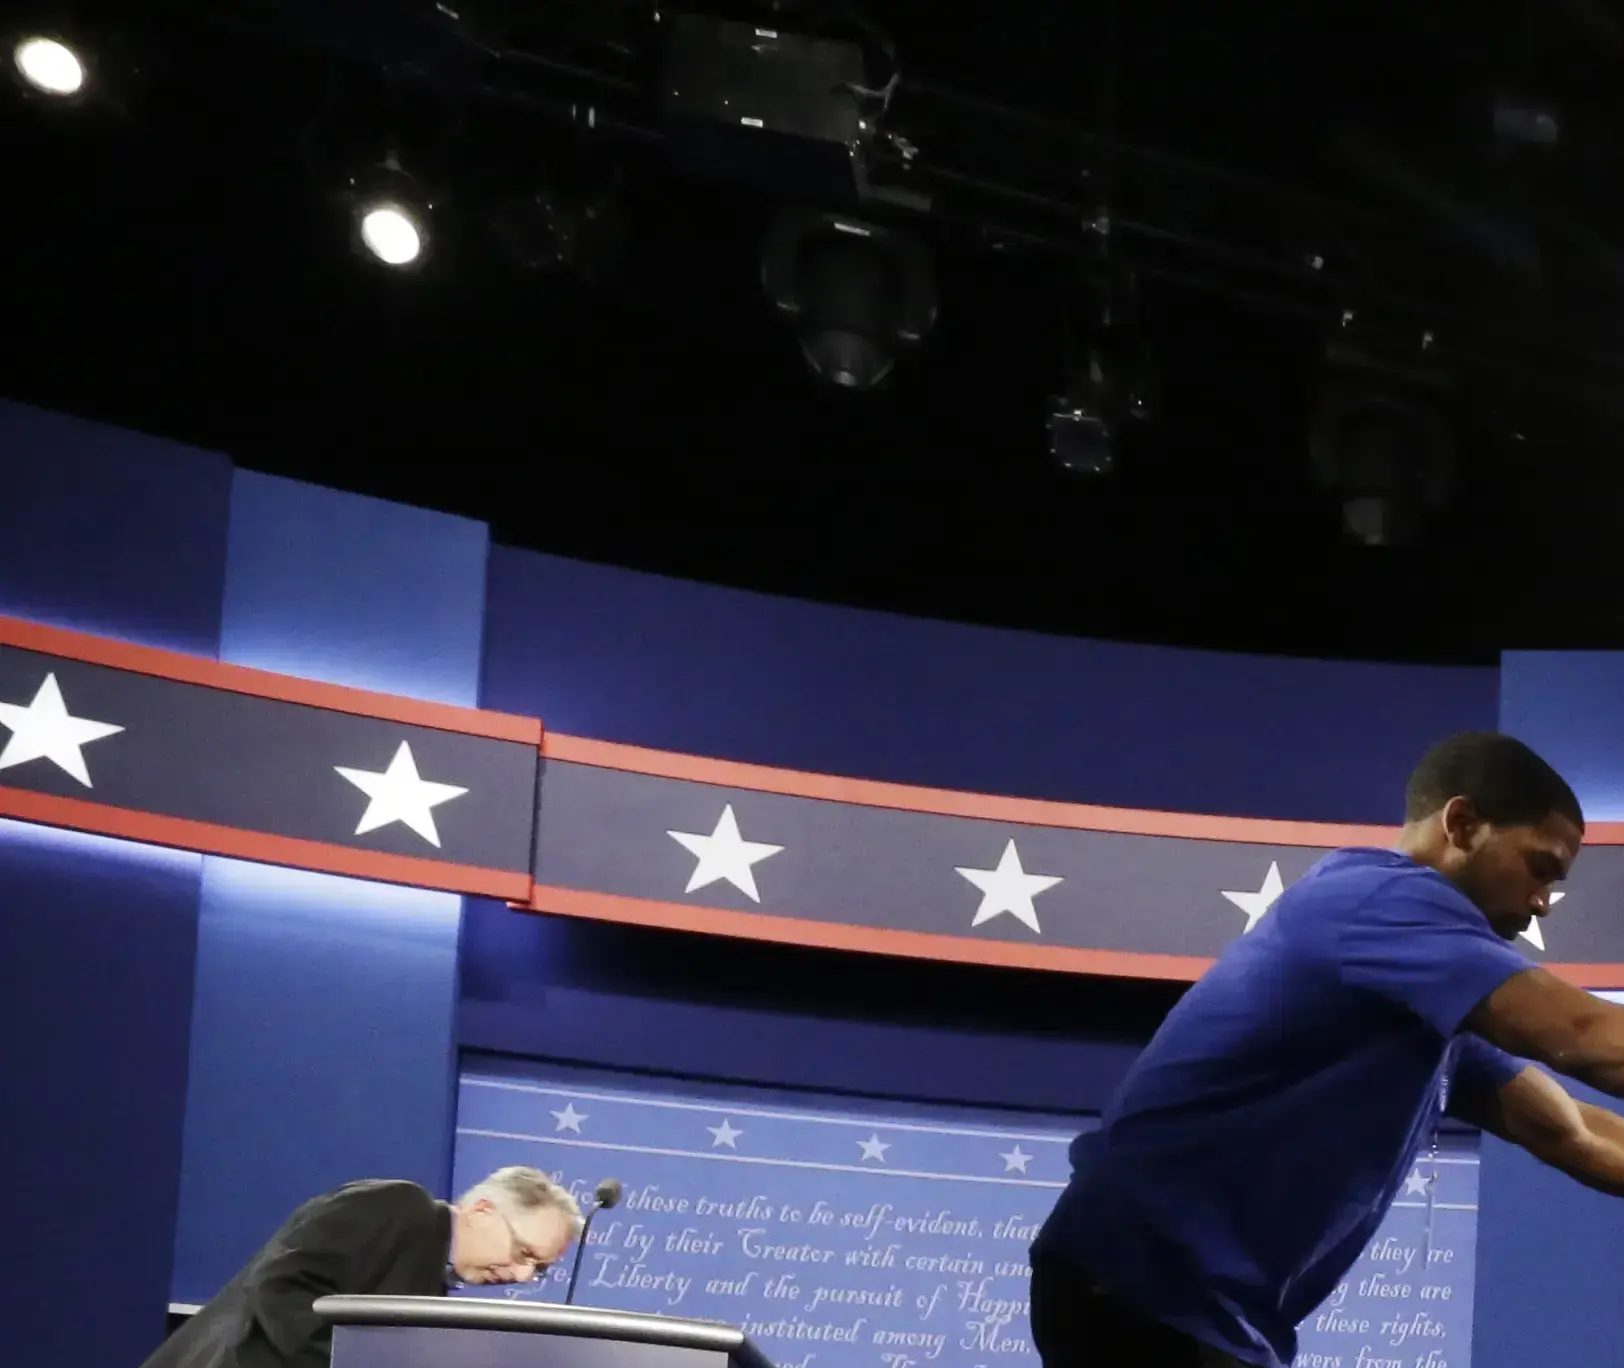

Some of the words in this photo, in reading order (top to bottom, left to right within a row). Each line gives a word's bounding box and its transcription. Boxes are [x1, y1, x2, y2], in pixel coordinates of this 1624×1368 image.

[623, 1224, 655, 1264] by
[665, 1227, 724, 1255] their
[737, 1227, 835, 1263] Creator
[845, 1243, 902, 1268] with
[905, 1252, 984, 1274] certain
[1358, 1272, 1412, 1298] these
[1420, 1285, 1452, 1301] are
[625, 1183, 690, 1215] these
[696, 1195, 774, 1221] truths
[779, 1204, 801, 1223] to
[807, 1200, 834, 1226] be
[840, 1203, 983, 1241] self-evident,
[1370, 1236, 1417, 1276] they
[588, 1252, 692, 1306] Liberty
[705, 1271, 759, 1296] and
[763, 1273, 801, 1300] the
[804, 1284, 903, 1313] pursuit
[916, 1284, 947, 1321] of
[1316, 1308, 1370, 1334] these
[1380, 1311, 1446, 1347] rights,
[740, 1312, 867, 1343] instituted
[872, 1330, 947, 1360] among
[959, 1325, 1031, 1354] Men,
